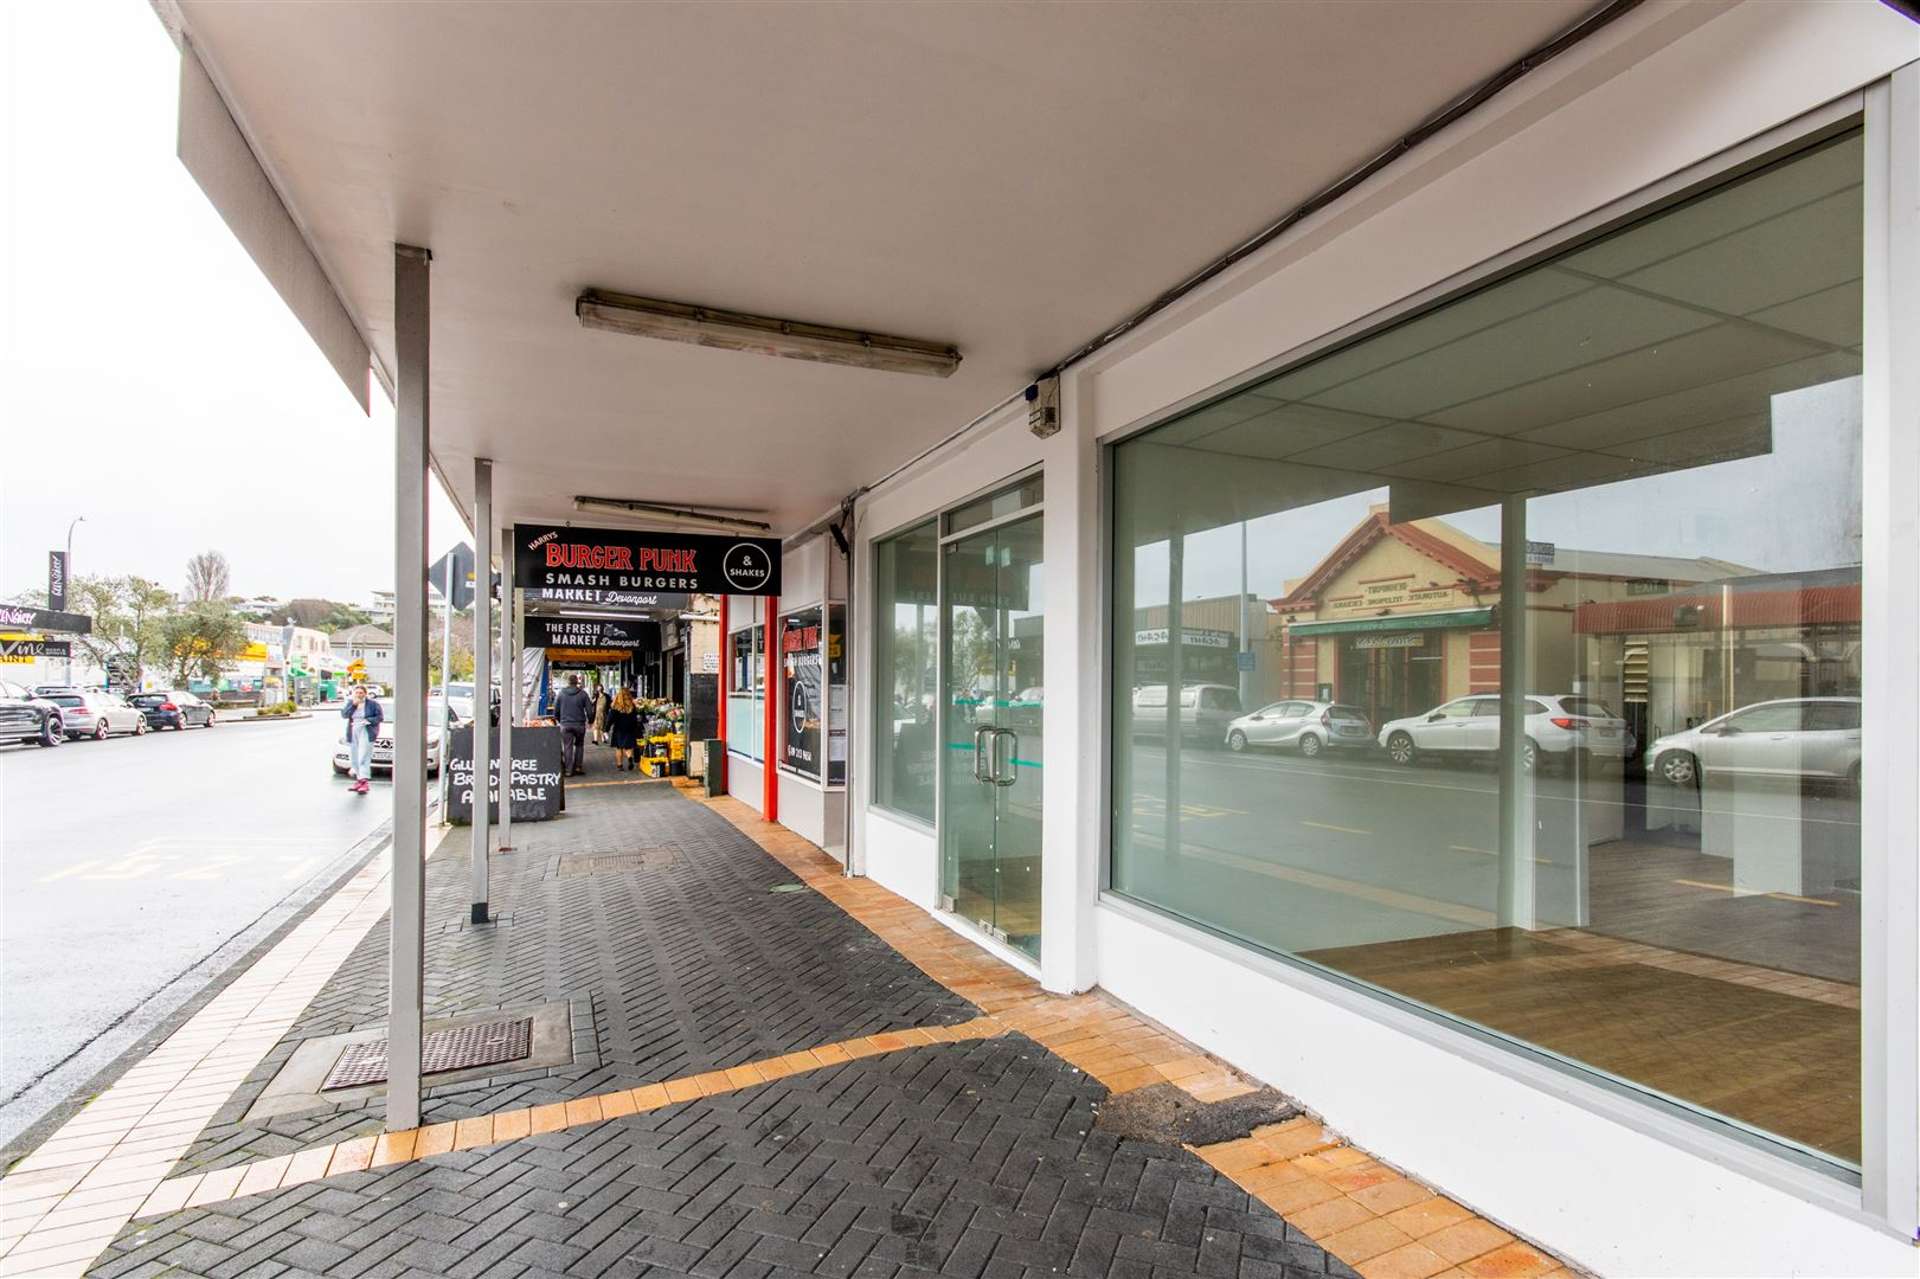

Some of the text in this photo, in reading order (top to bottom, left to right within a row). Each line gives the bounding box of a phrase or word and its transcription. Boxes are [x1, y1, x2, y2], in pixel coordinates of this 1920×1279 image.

[528, 531, 559, 551] HARRYS
[545, 543, 698, 574] BURGER PUNK
[743, 555, 752, 566] &
[729, 568, 765, 578] SHAKES
[545, 573, 699, 589] SMASH BURGERS
[542, 588, 657, 605] MARKET Devonport
[545, 623, 600, 634] THE FRESH
[552, 634, 640, 648] MARKET Devonport
[450, 757, 537, 771] GLUN REE
[453, 771, 561, 787] BRD PASTRY
